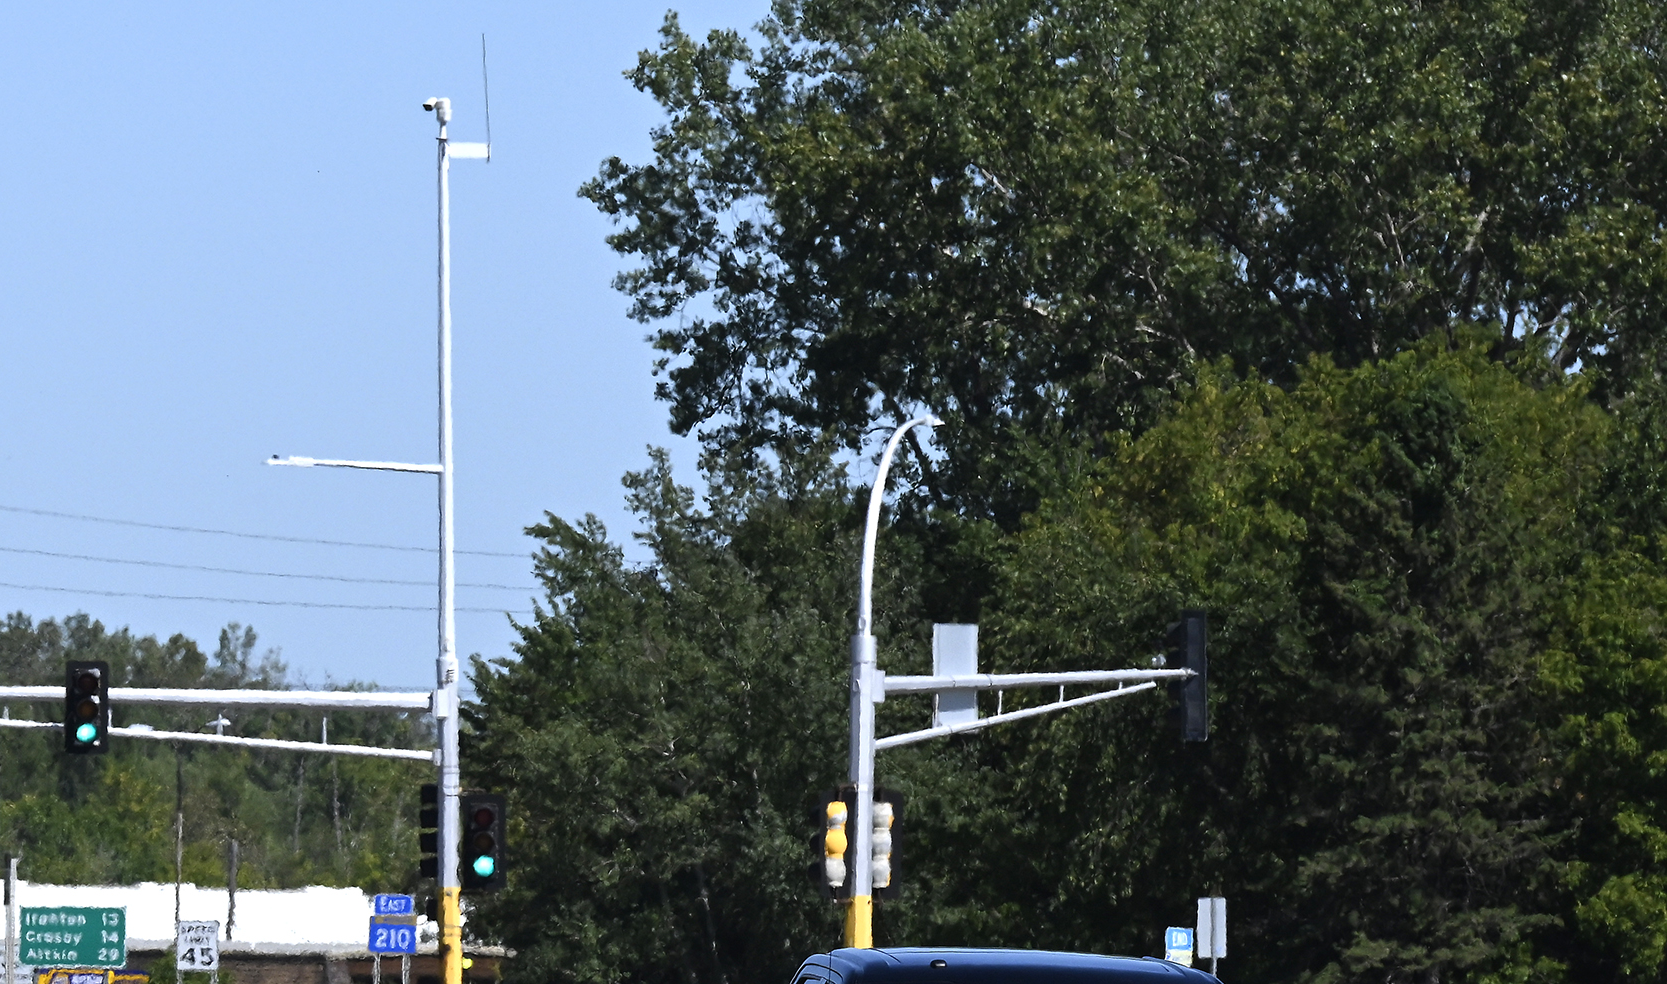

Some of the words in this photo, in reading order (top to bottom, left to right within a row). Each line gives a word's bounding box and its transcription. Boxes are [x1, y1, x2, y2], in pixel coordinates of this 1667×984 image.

[379, 896, 406, 913] EAST
[25, 912, 87, 926] Ironton
[101, 912, 119, 926] 13
[25, 930, 83, 946] Crosby
[100, 929, 119, 943] 14
[375, 928, 411, 950] 210
[97, 947, 120, 961] 29
[180, 947, 214, 966] 45
